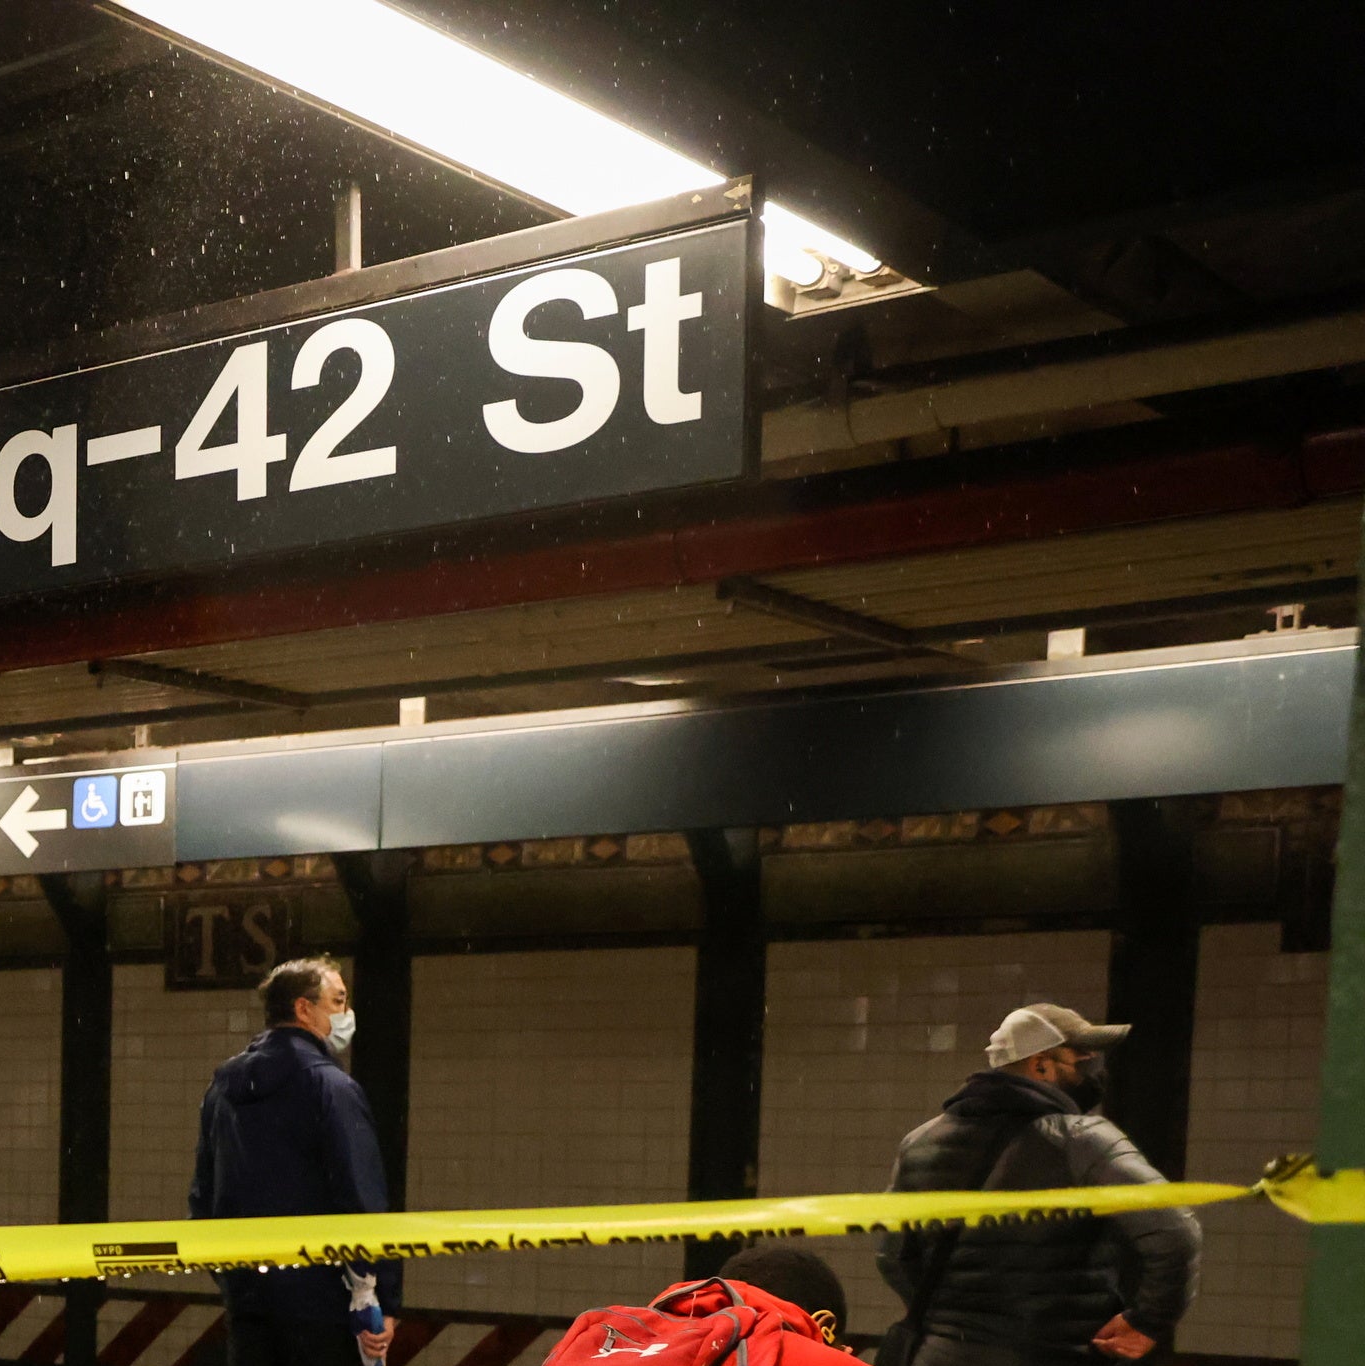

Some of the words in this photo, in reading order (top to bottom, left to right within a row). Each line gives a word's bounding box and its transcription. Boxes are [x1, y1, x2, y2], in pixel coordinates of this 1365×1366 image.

[482, 256, 703, 455] St
[186, 904, 276, 977] TS
[94, 1245, 123, 1255] NYPD
